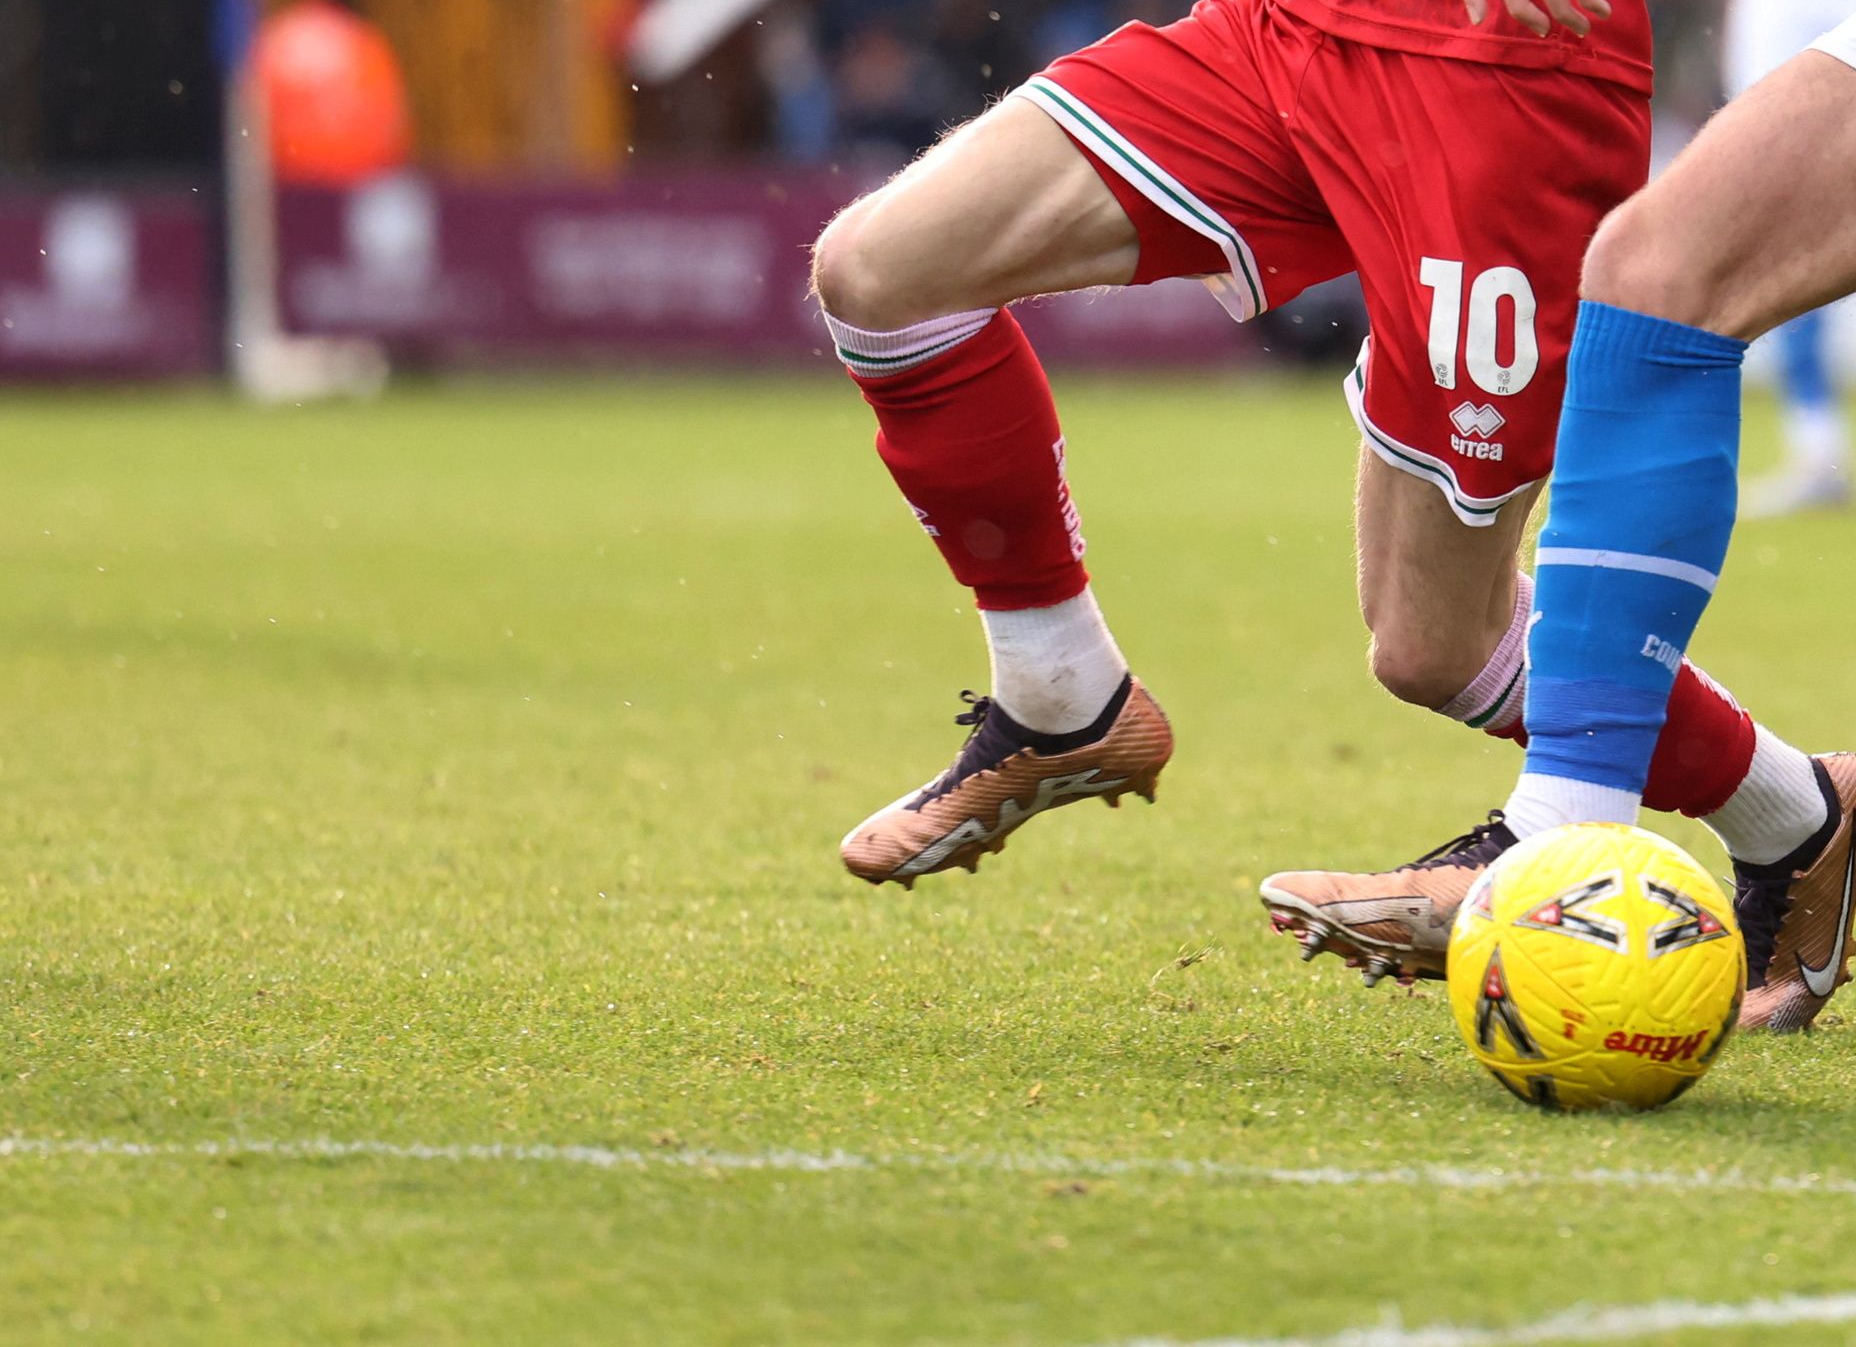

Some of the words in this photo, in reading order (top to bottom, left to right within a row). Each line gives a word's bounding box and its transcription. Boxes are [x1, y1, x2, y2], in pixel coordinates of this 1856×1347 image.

[1419, 256, 1539, 396] 10
[1450, 434, 1503, 461] errea
[1604, 1029, 1710, 1063] Mitre
